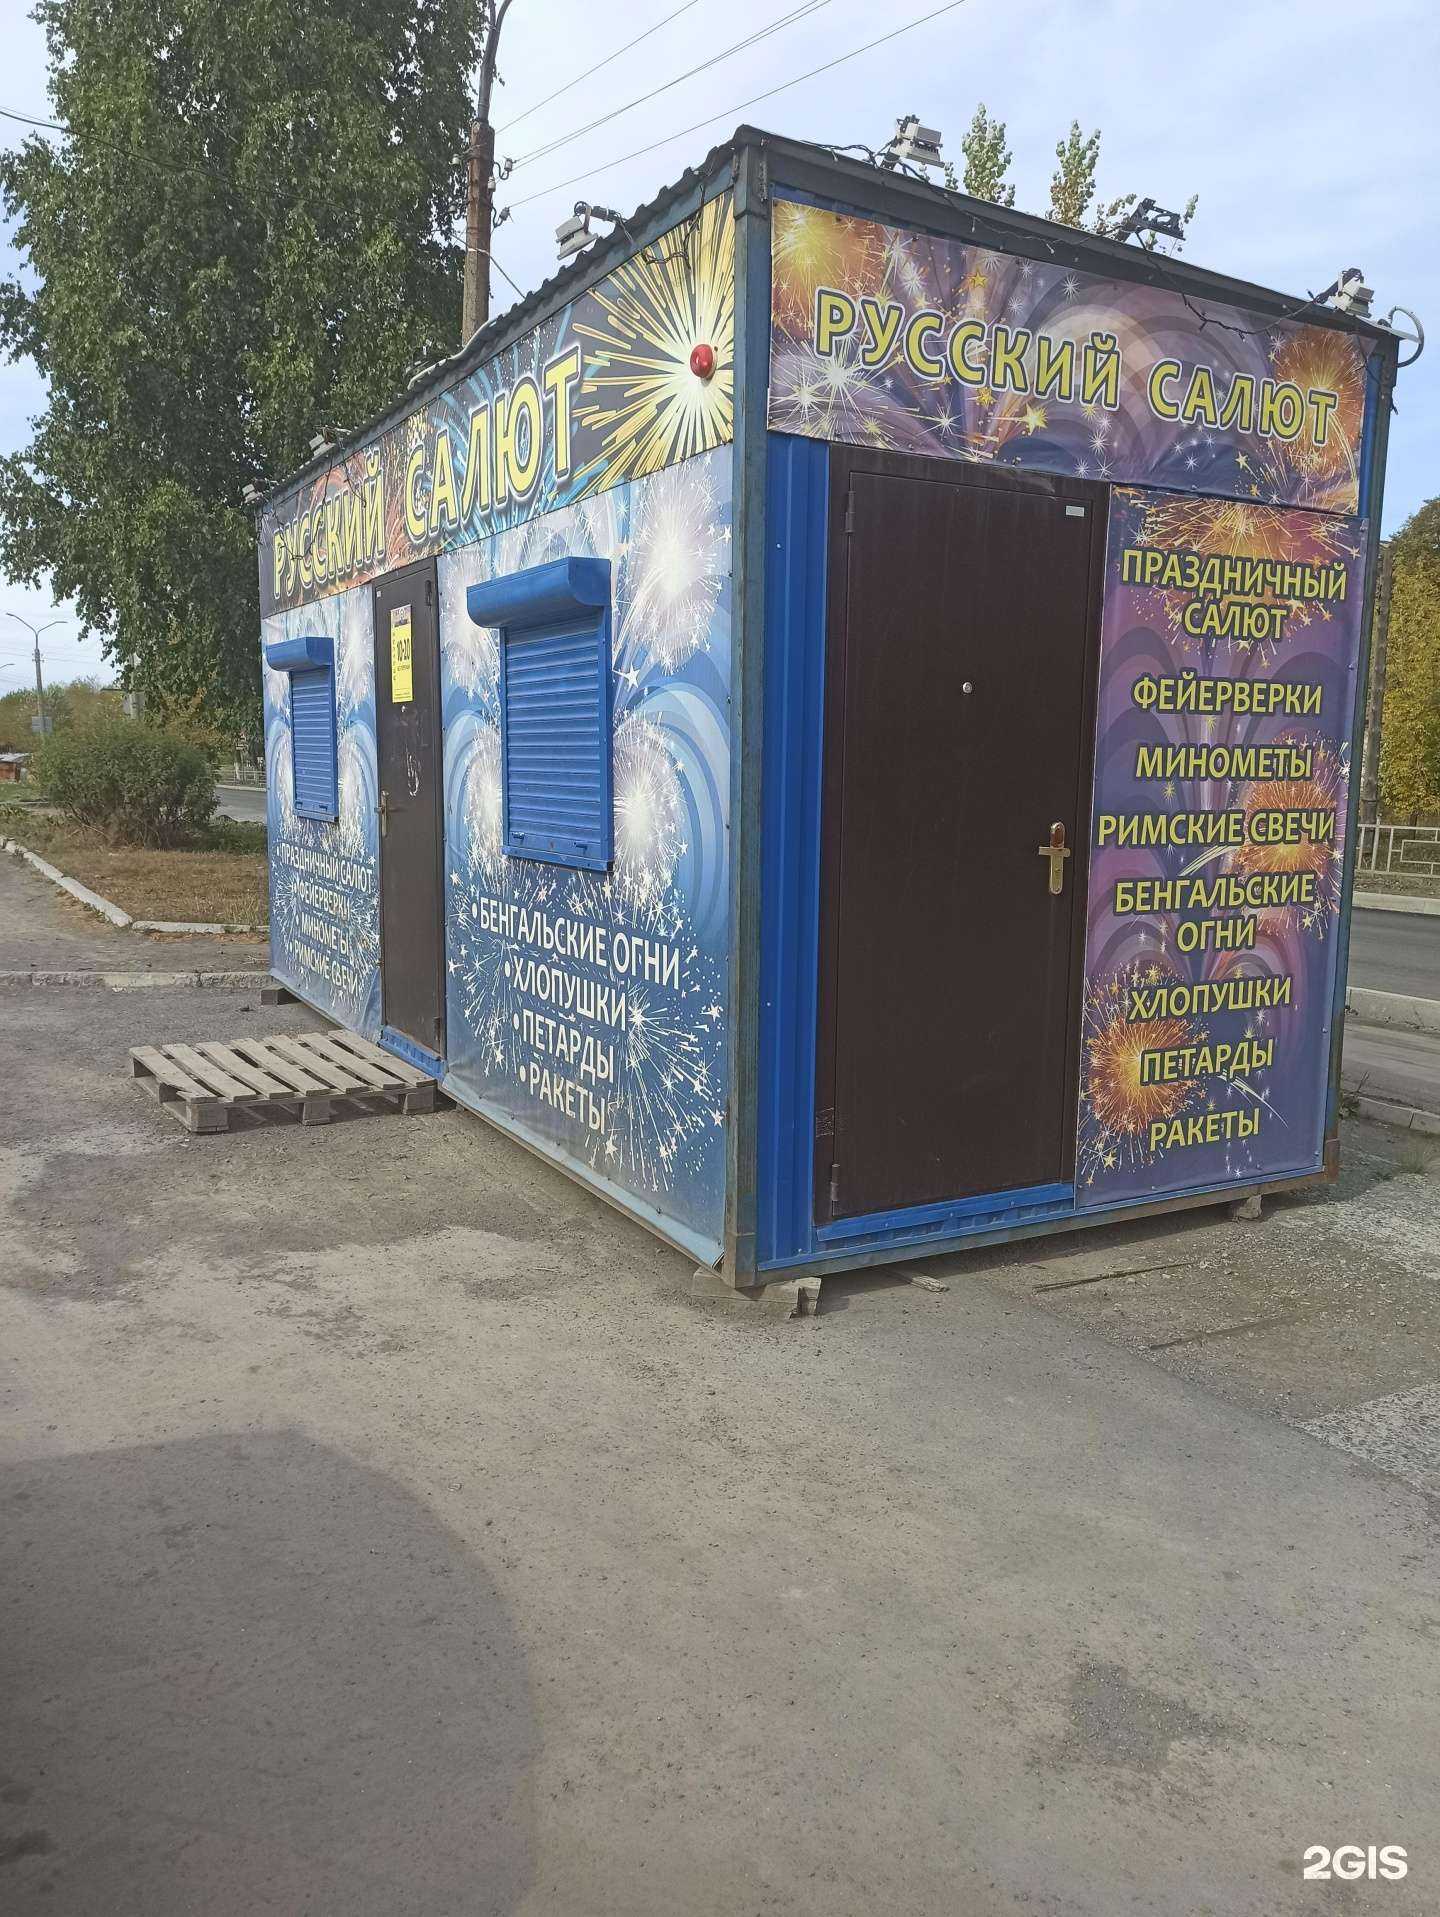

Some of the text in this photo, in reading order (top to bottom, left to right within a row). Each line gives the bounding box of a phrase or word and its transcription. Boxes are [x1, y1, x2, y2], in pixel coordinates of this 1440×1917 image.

[815, 287, 1337, 446] РУССКИЙ САЛЮТ
[273, 343, 580, 599] РУССКИЙ САЛЮТ
[1121, 549, 1348, 600] ПРАЗДНИЧНЫЙ
[1183, 602, 1287, 639] САЛЮТ
[1132, 671, 1322, 714] ФЕЙЕРВЕРКИ
[1135, 746, 1312, 778] МИНОМЕТЫ
[1097, 811, 1335, 846] РИМСКИЕ СВЕЧИ
[280, 842, 373, 894] ПРАЗДНИЧНЫЙ САЛЮТ
[299, 877, 350, 921] ФЕЙЕРВЕРКИ
[1115, 873, 1315, 913] БЕНГАЛЬСКИЕ
[301, 911, 350, 955] МИНОМЕТЫ
[480, 897, 679, 990] БЕНГАЛЬСКИЕ ОГНИ
[1177, 917, 1256, 952] ОГНИ
[294, 939, 358, 997] РИМСКИЕ СВЕЧИ
[513, 956, 626, 1031] ХЛОПУШКИ
[1129, 977, 1291, 1020] ХЛОПУШКИ
[522, 1009, 614, 1086] ПЕТАРДЫ
[1142, 1039, 1273, 1082] ПЕТАРДЫ
[530, 1062, 605, 1135] РАКЕТЫ
[1150, 1107, 1260, 1151] РАКЕТЫ
